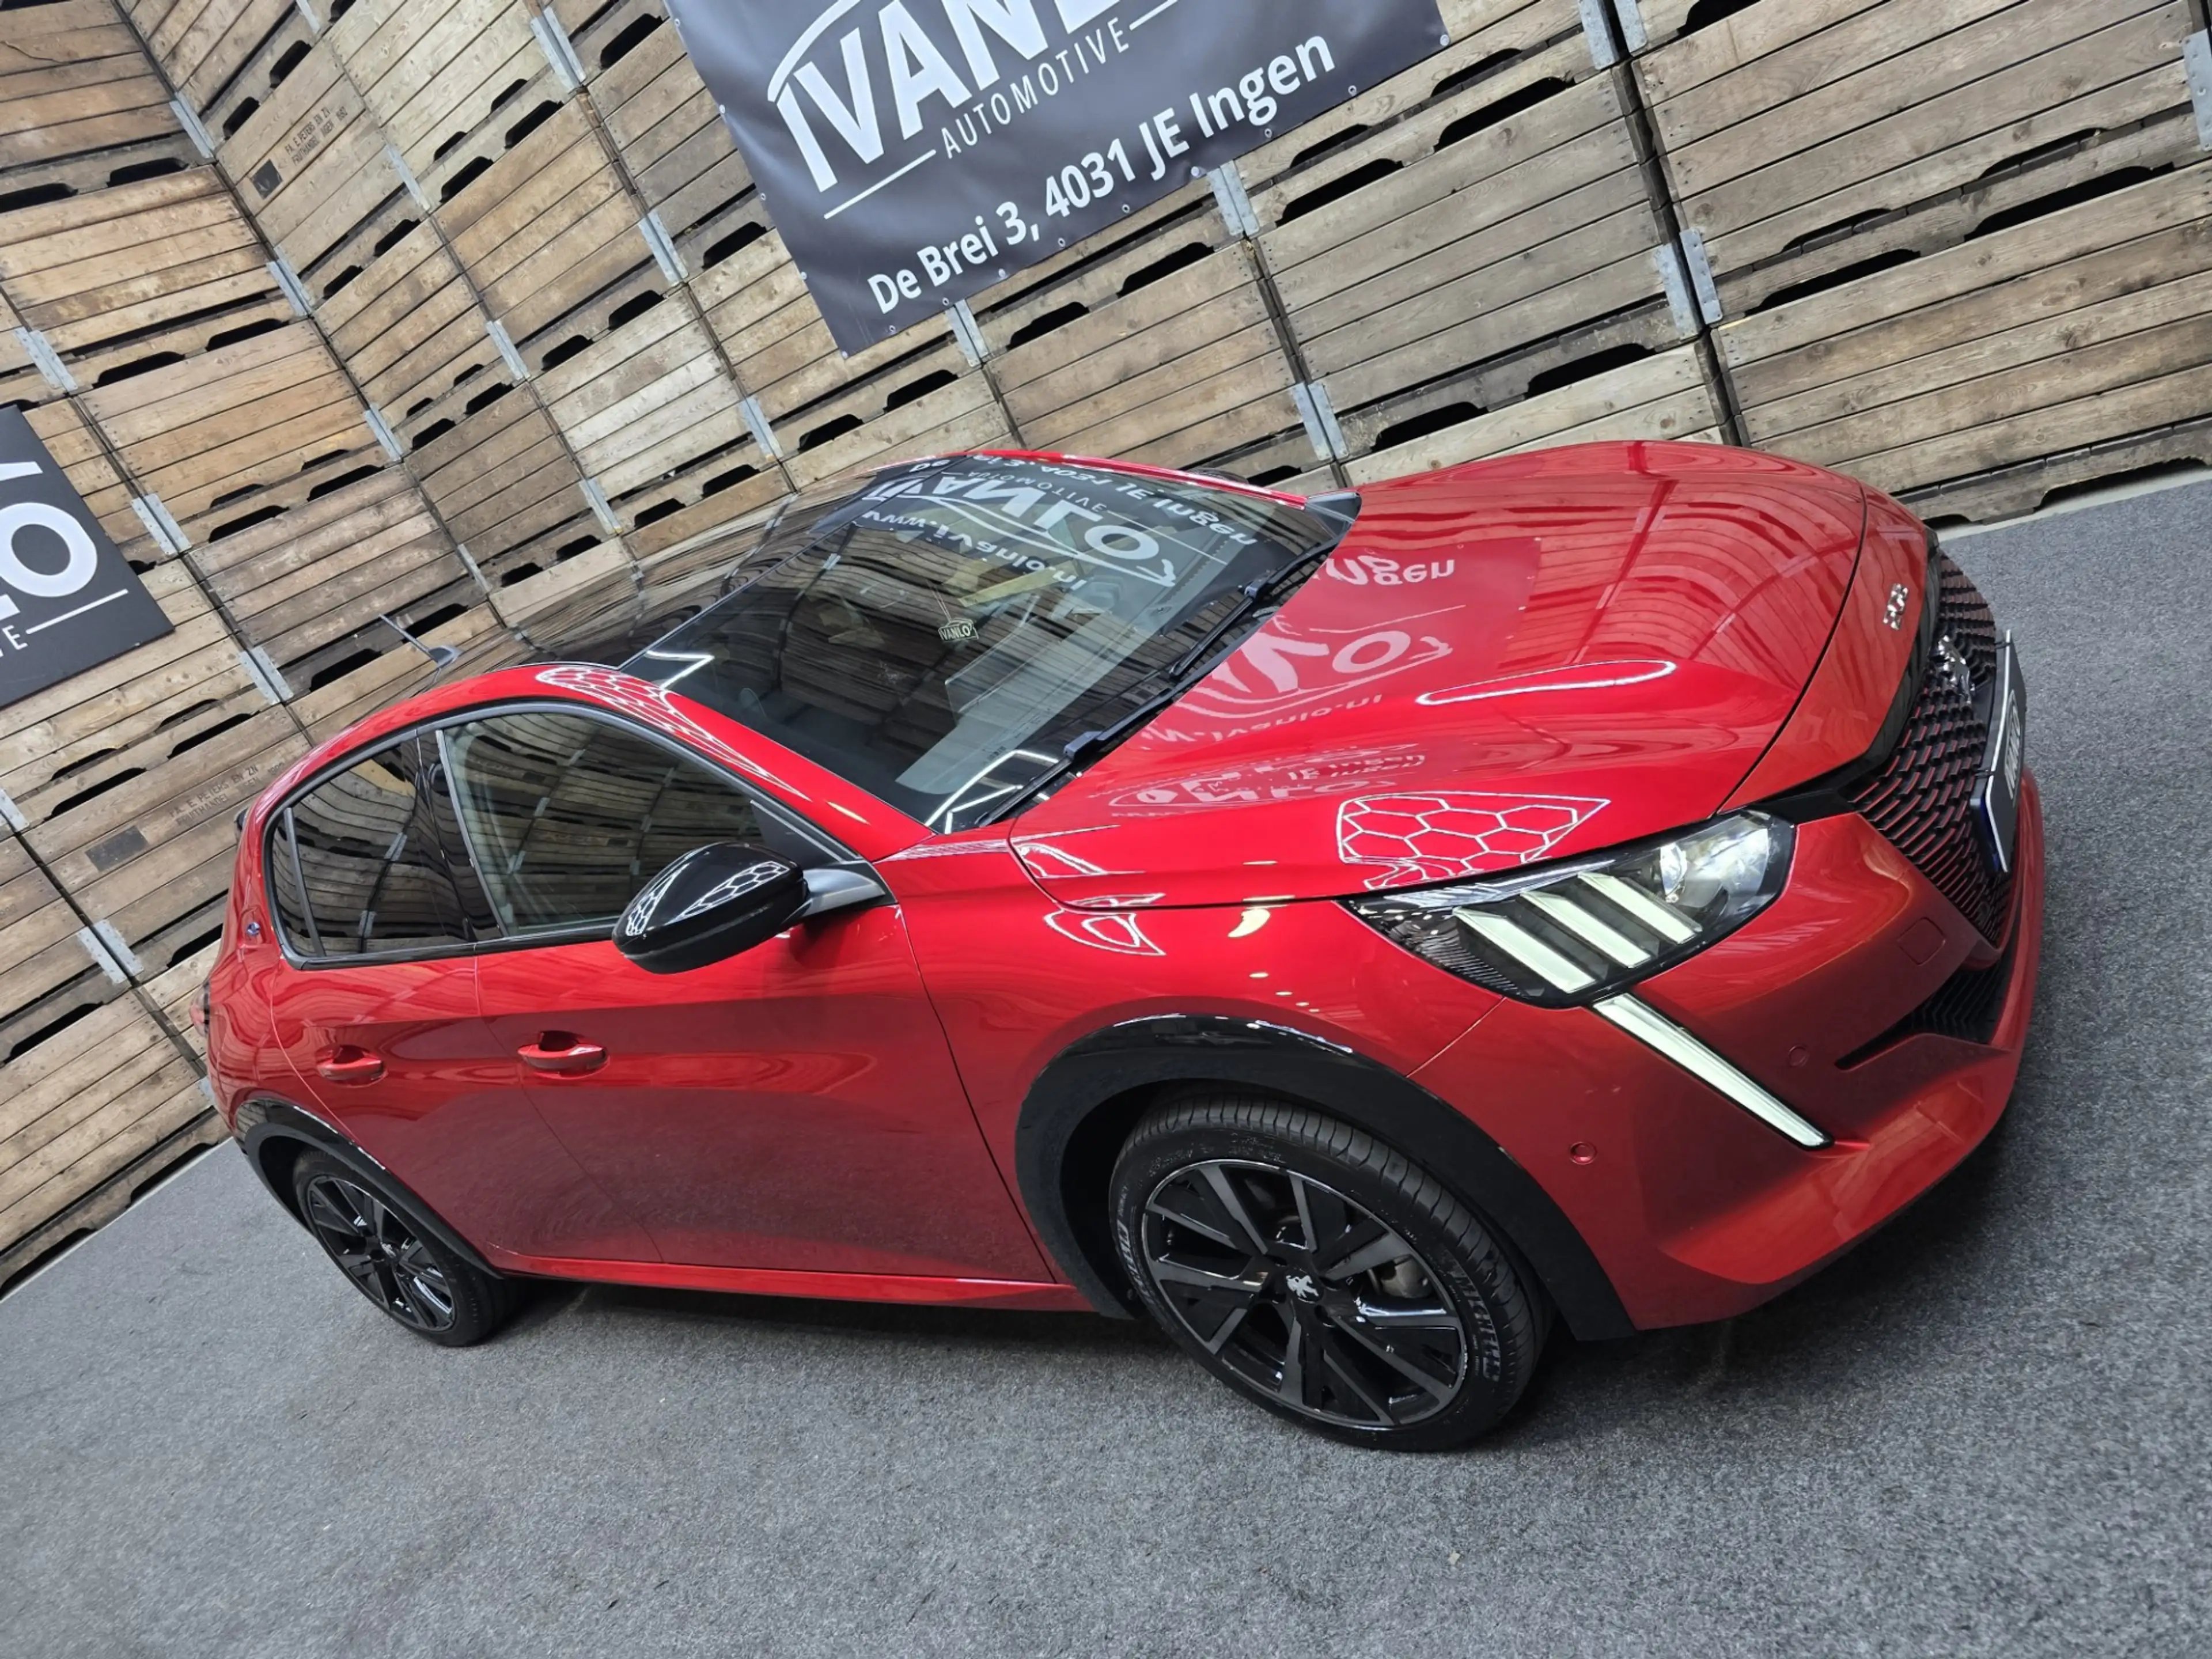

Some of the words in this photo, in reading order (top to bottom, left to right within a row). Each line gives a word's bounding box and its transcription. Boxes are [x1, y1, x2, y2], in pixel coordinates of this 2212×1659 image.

[867, 267, 922, 315] De
[916, 215, 999, 287] Brei
[995, 200, 1040, 242] 3,
[1045, 138, 1136, 218] 4031
[1138, 107, 1190, 181] JE
[1188, 35, 1336, 138] Ingen
[940, 17, 1130, 159] AUTOMOTIVE
